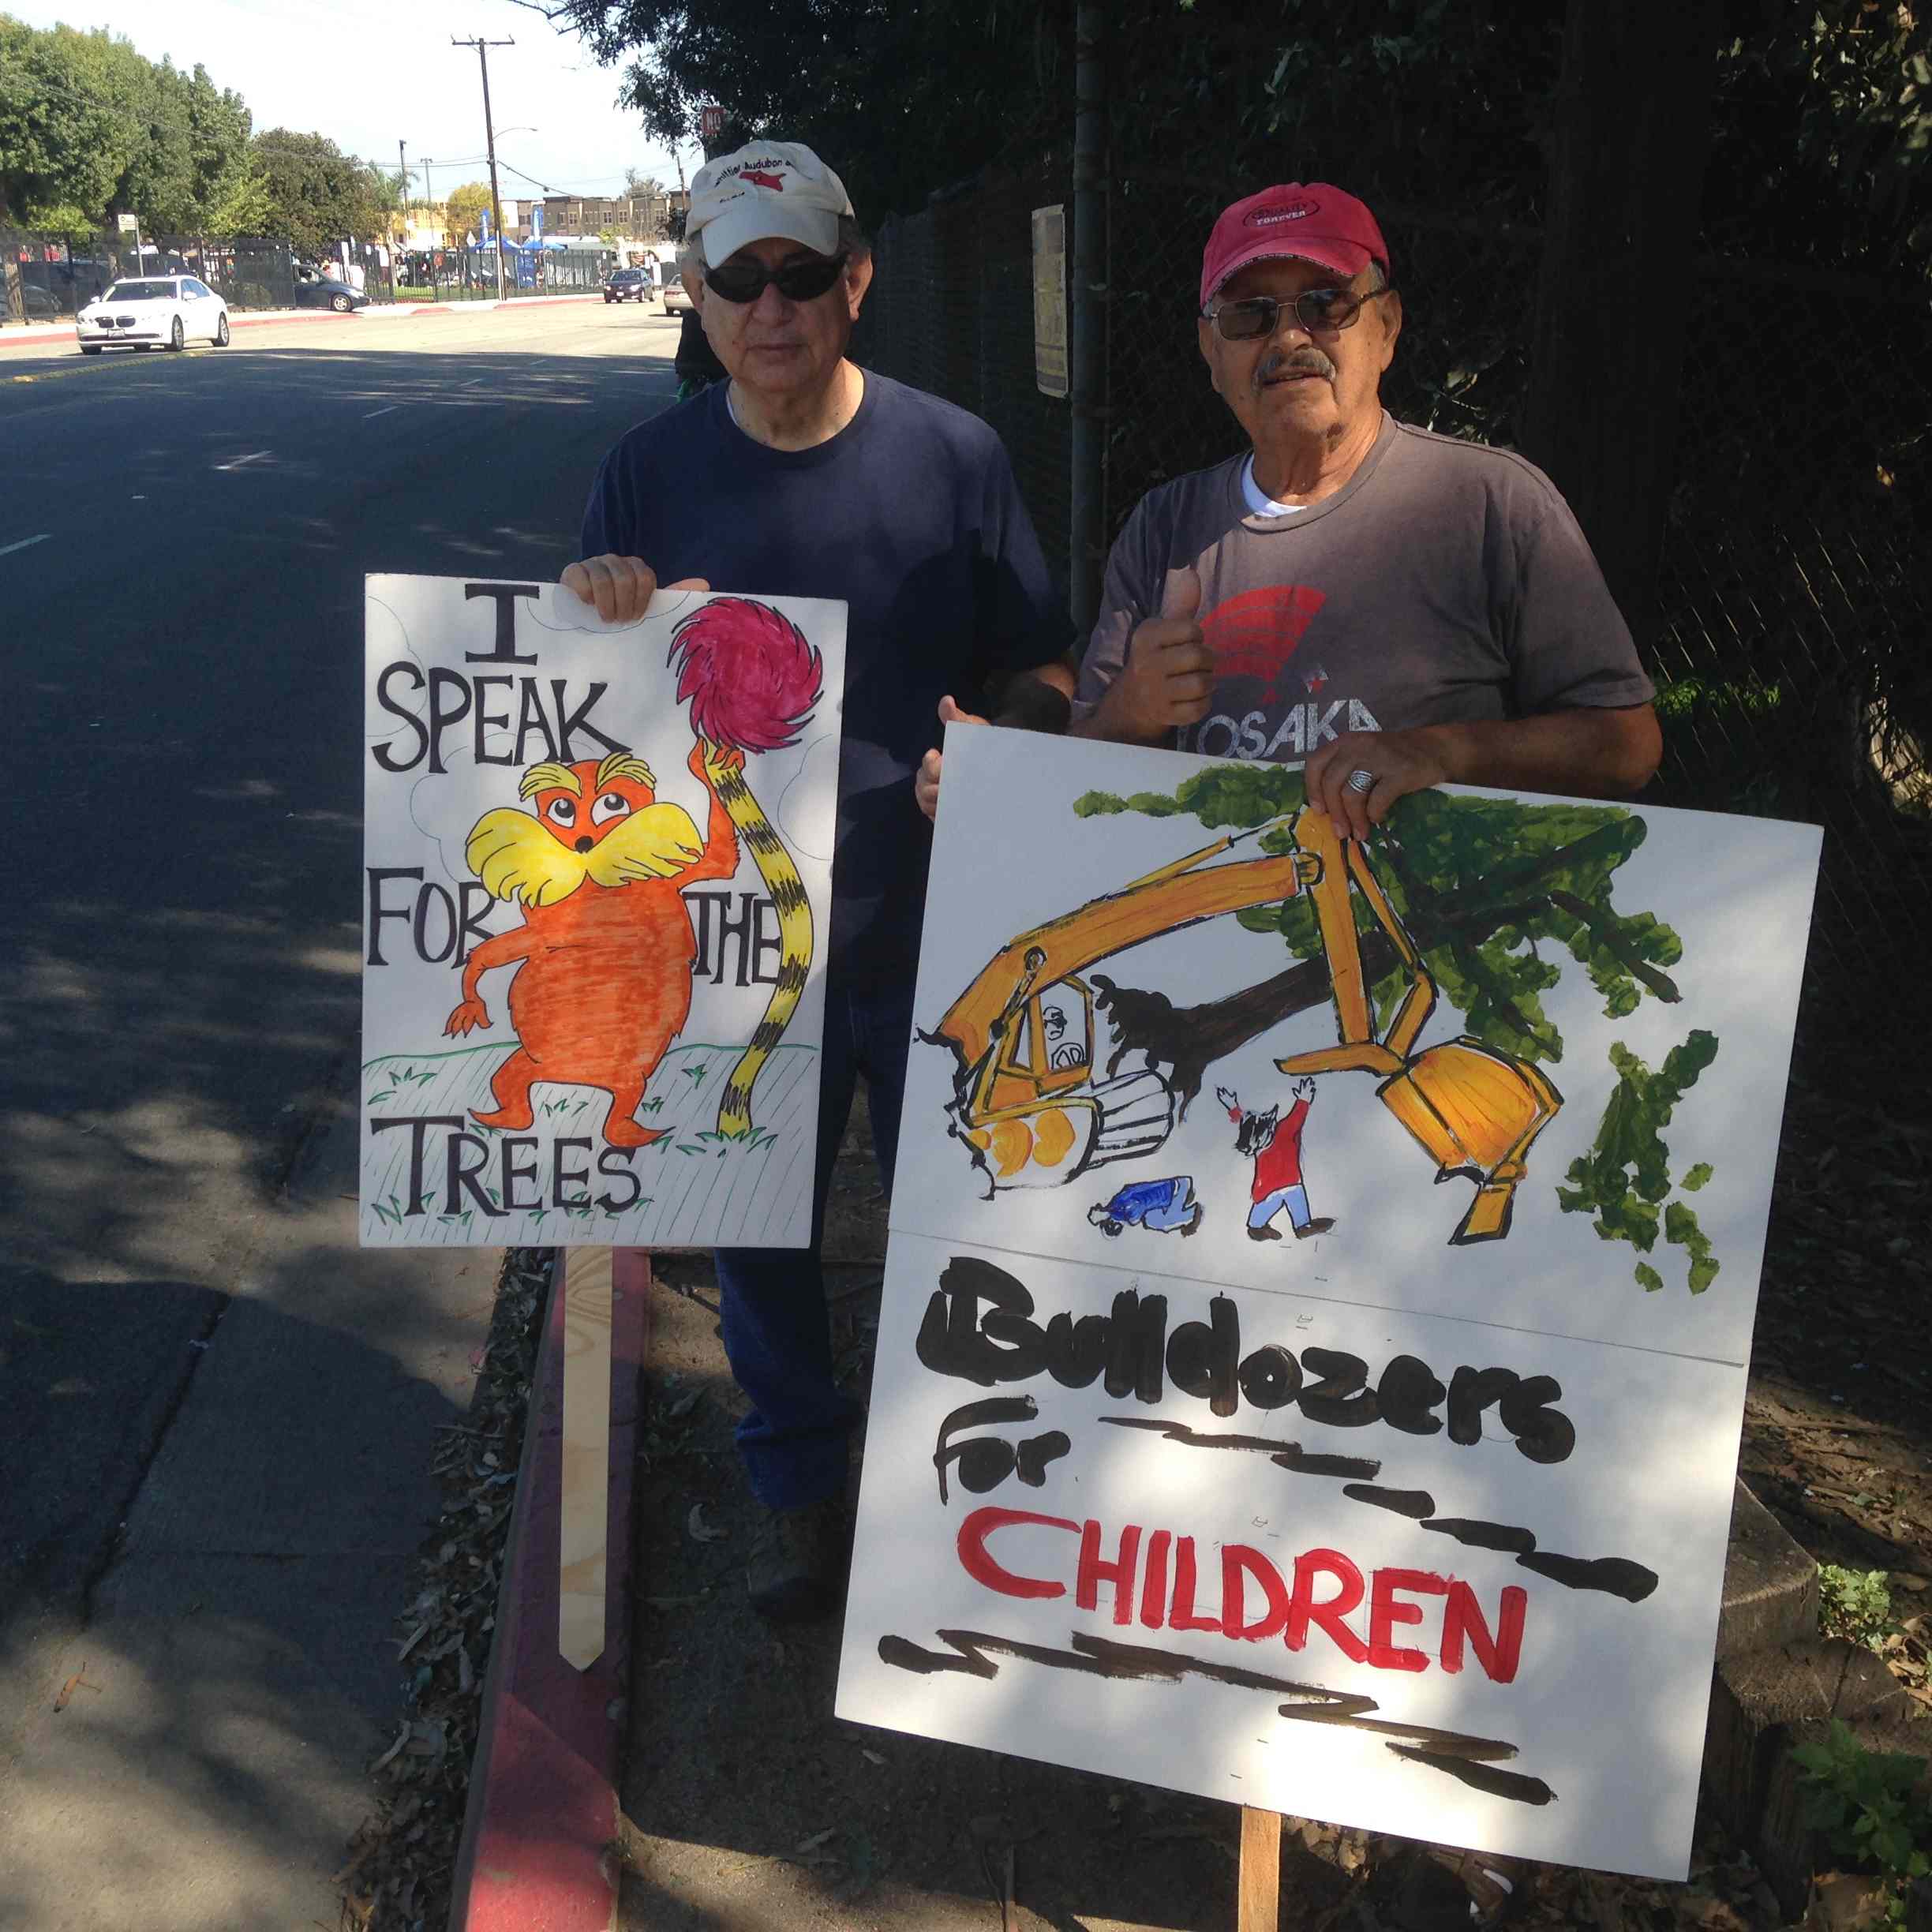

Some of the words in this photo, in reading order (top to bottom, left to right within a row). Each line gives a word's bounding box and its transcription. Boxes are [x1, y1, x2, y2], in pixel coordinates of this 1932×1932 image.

[744, 158, 783, 170] Audubon
[464, 583, 540, 665] I
[371, 661, 633, 774] SPEAK
[1196, 698, 1383, 760] OSAKA
[366, 867, 499, 970] FOR
[681, 891, 784, 987] THE
[369, 1115, 642, 1218] TREES
[915, 1256, 1577, 1465] Bulldozers
[933, 1394, 1072, 1505] for
[957, 1506, 1528, 1684] CHILDREN
